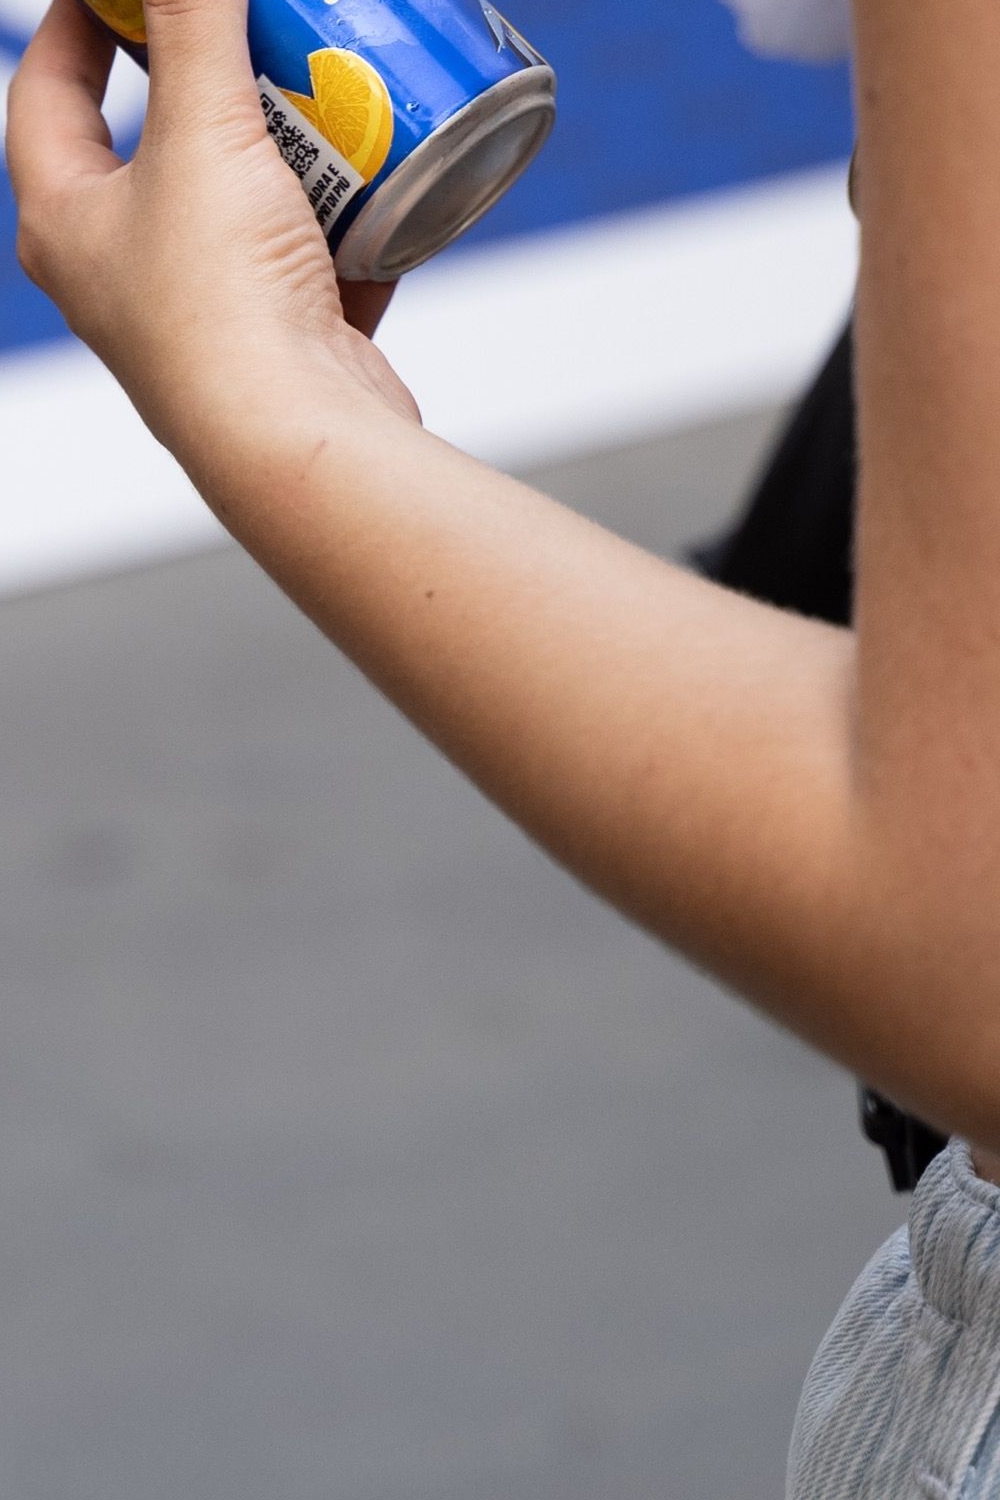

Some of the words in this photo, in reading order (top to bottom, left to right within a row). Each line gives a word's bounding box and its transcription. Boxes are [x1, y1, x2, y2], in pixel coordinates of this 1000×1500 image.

[326, 163, 340, 176] E
[324, 191, 339, 209] DI
[332, 175, 351, 198] PIÙ
